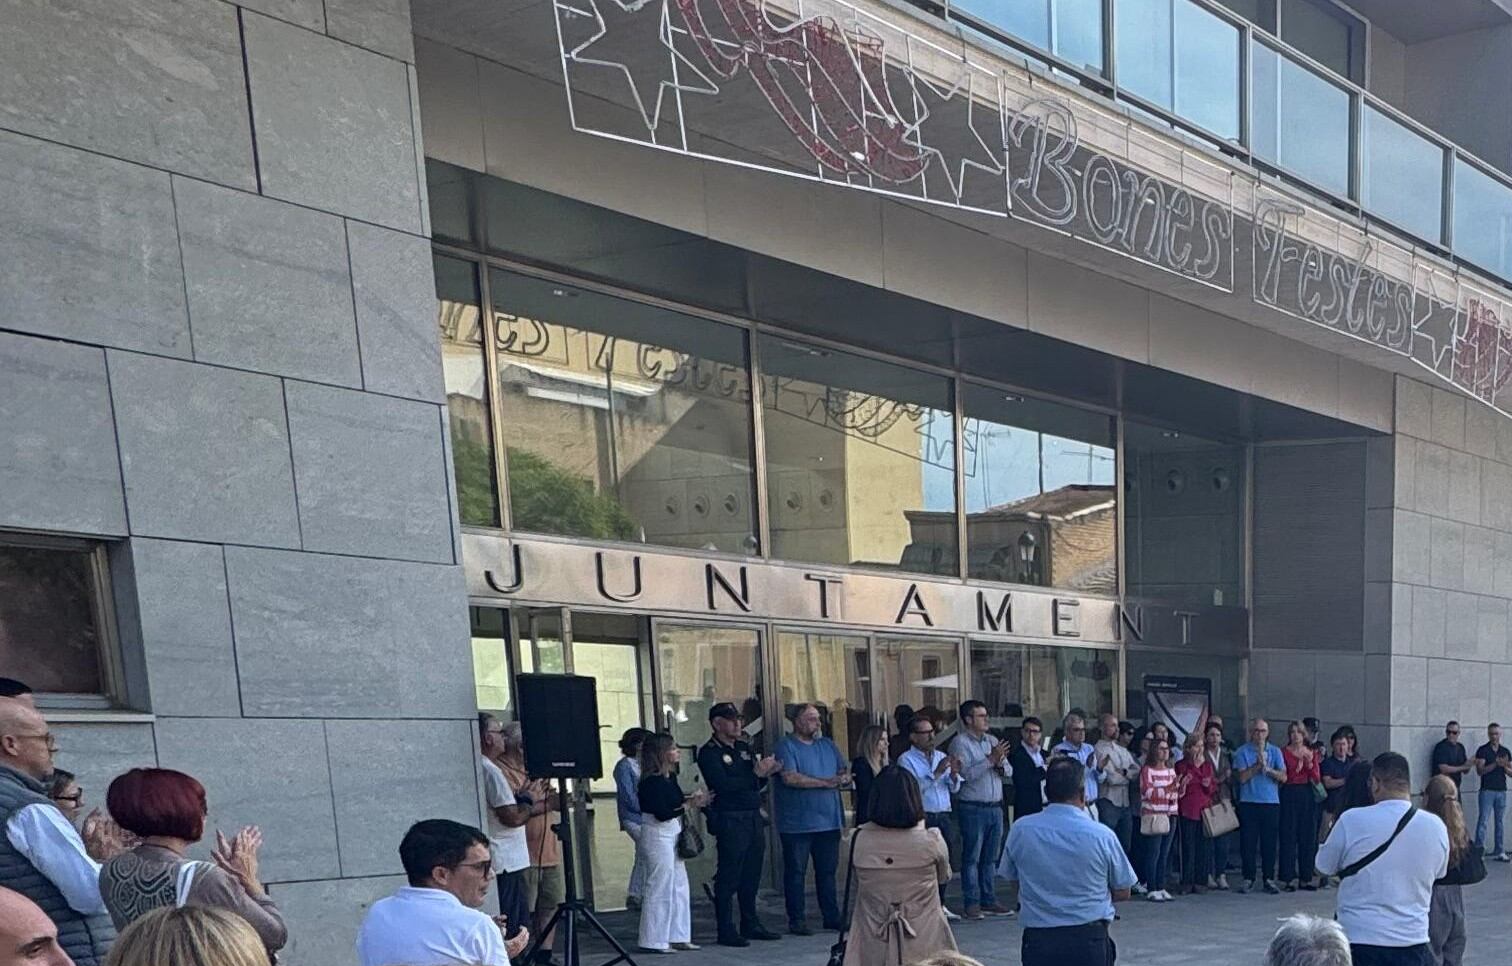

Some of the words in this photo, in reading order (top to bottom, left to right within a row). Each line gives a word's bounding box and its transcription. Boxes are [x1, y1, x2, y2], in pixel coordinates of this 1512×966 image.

[1008, 97, 1231, 279] Bones
[1255, 198, 1413, 347] Festes
[484, 543, 1201, 646] JUNTAMENT
